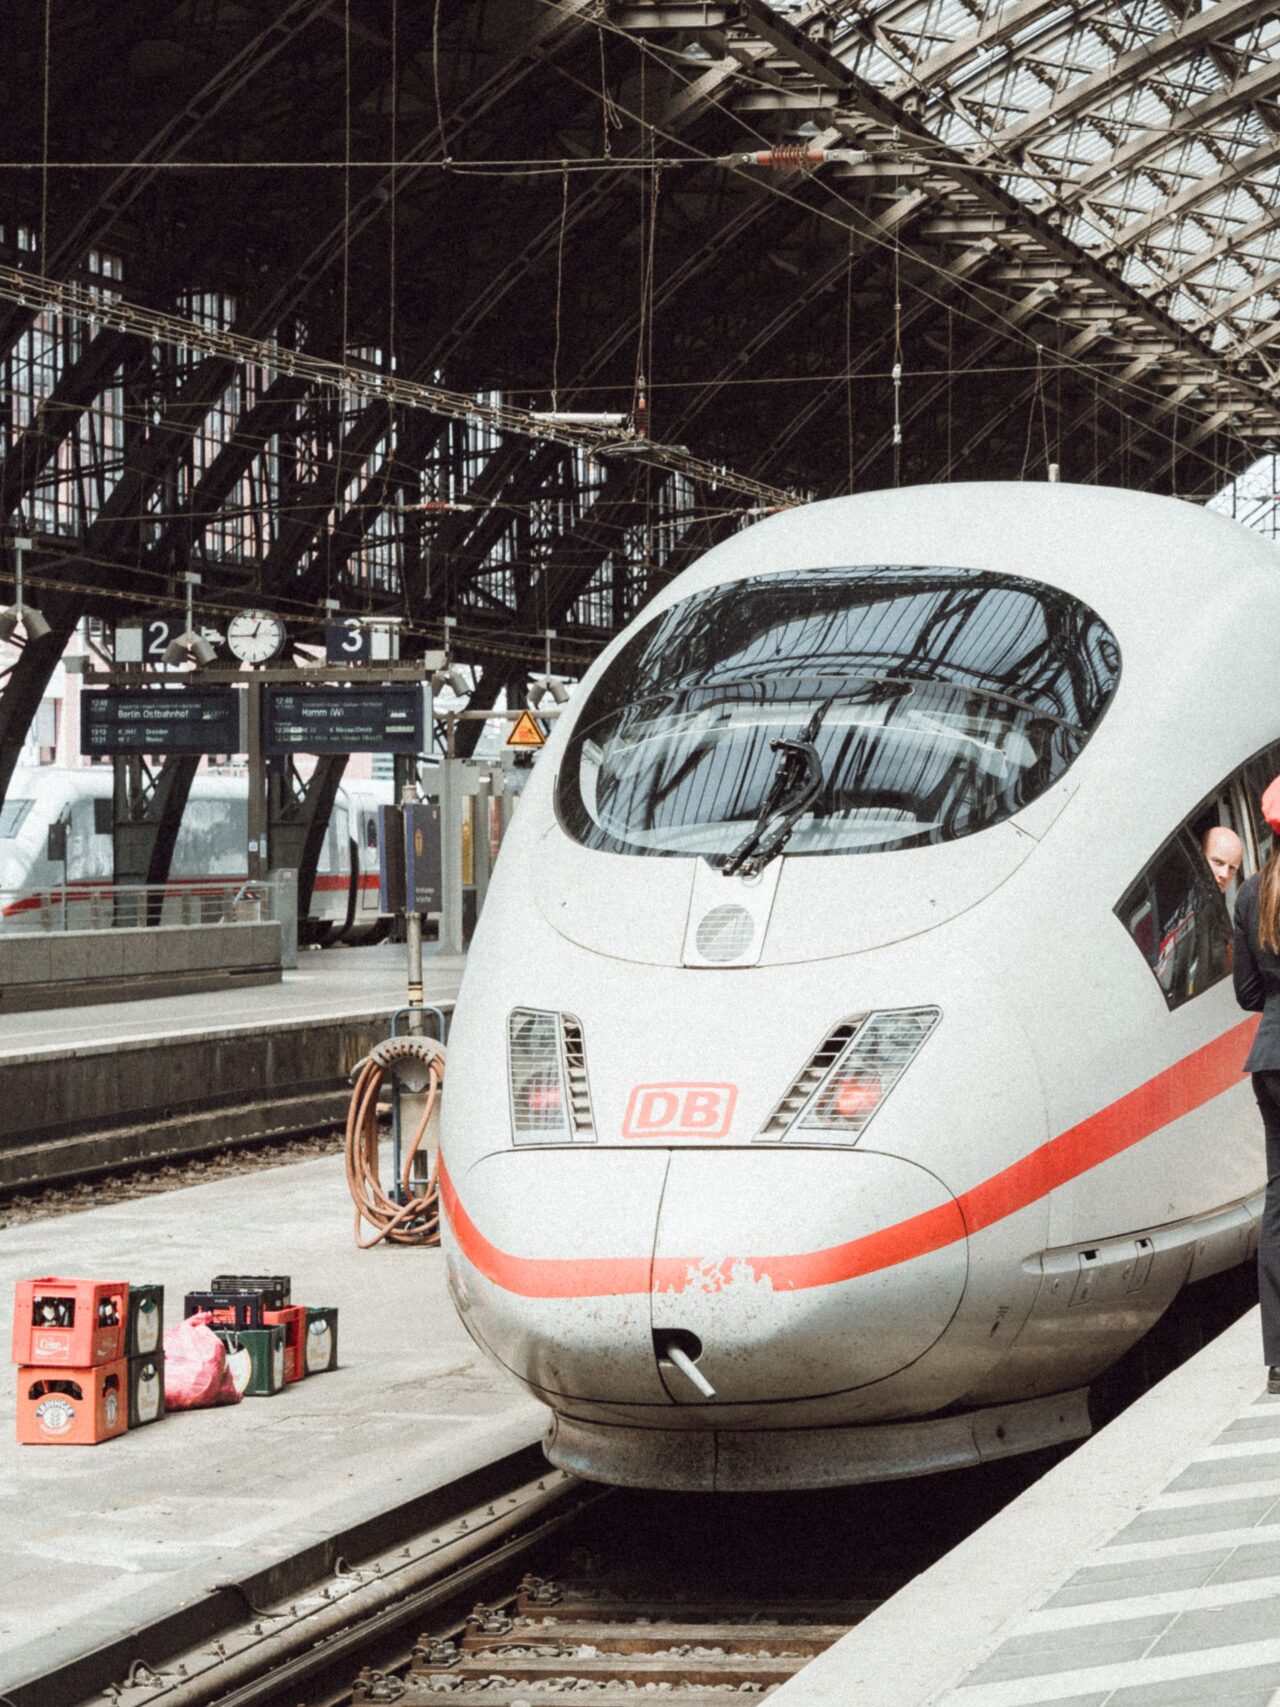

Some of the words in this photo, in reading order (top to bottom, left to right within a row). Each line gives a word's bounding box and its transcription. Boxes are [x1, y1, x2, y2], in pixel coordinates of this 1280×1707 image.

[149, 621, 169, 654] 2
[341, 618, 363, 652] 3
[118, 710, 141, 719] Berlin
[143, 709, 189, 719] Ostbahnhof
[302, 708, 327, 717] Hamm
[636, 1090, 723, 1129] DB
